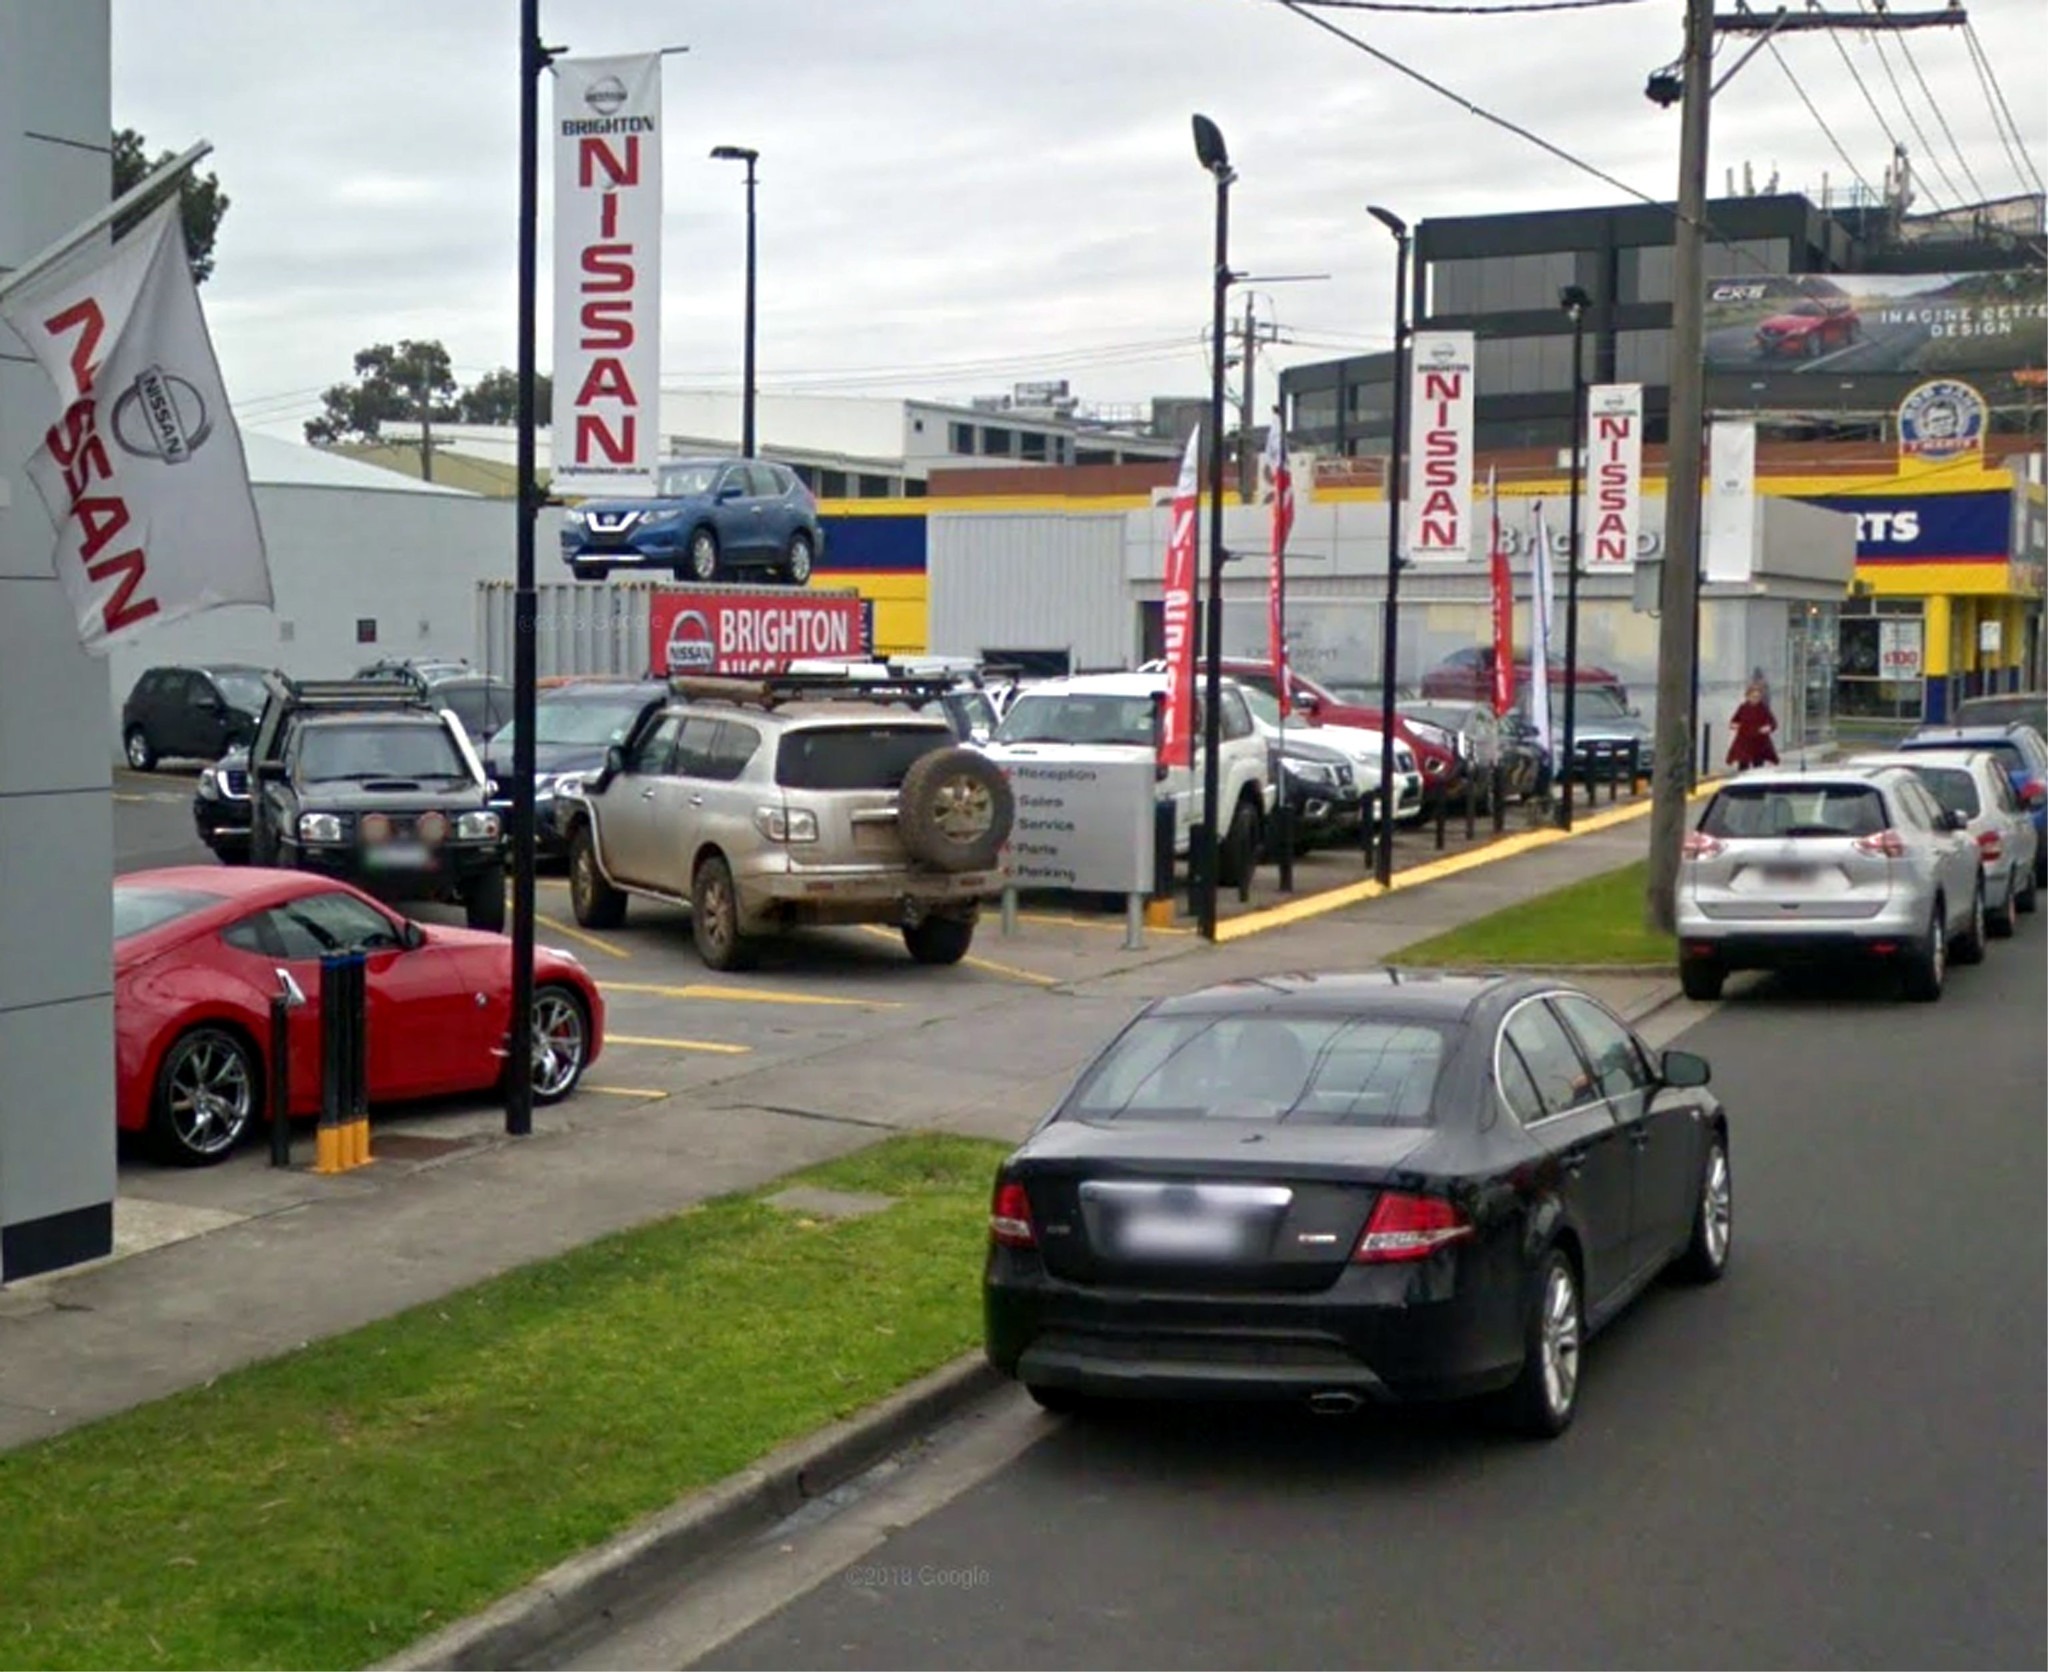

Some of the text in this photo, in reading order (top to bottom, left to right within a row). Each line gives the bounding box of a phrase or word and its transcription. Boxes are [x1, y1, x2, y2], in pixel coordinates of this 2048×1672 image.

[562, 116, 654, 135] BRIGHTON
[575, 135, 638, 464] NISSAN
[1881, 308, 1972, 324] IMAGINE
[1931, 322, 2012, 337] DESIGN
[144, 375, 183, 455] NISSAN
[44, 297, 160, 633] NSSAN
[1421, 373, 1460, 546] NISSAN
[1596, 417, 1630, 560] NISSAN
[719, 609, 849, 653] BRIGHTON
[669, 646, 713, 661] NISSAN
[1018, 767, 1097, 781] Reception
[1019, 795, 1064, 807] Sales
[1019, 817, 1075, 832] Service
[1018, 843, 1057, 856] Parts
[1018, 866, 1076, 883] Parking
